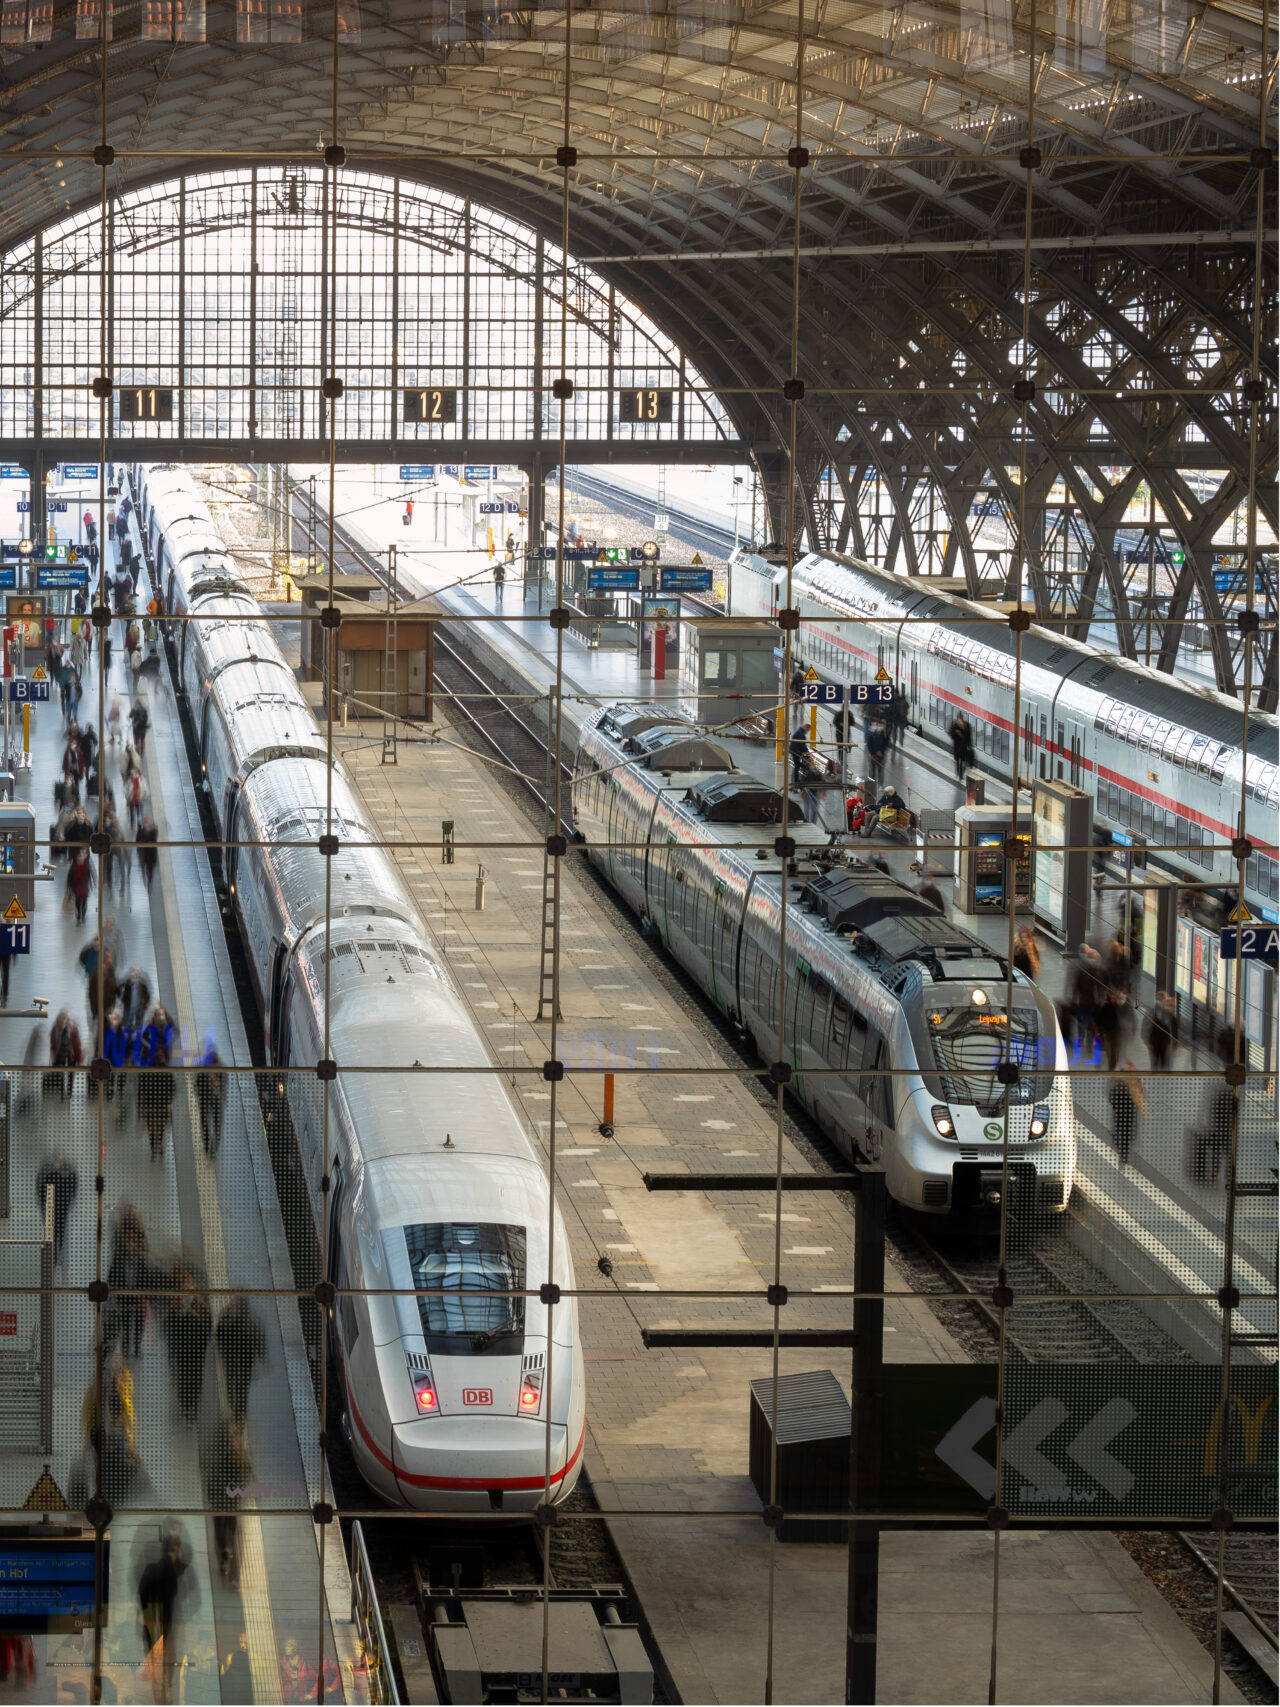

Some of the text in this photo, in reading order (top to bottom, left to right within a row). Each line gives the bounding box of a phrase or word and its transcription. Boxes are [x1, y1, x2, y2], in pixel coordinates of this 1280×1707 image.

[135, 389, 157, 417] 11
[419, 391, 442, 419] 12
[635, 391, 658, 419] 13
[59, 502, 67, 511] 11
[481, 503, 501, 512] 12 D
[87, 546, 96, 555] 11
[544, 548, 552, 558] C
[16, 682, 47, 698] B 11
[802, 685, 836, 700] 12 B
[857, 685, 893, 701] B 13
[6, 925, 27, 947] 11
[979, 1013, 1000, 1025] Leipzig
[465, 1390, 491, 1404] DB
[10, 1567, 28, 1579] Hbf
